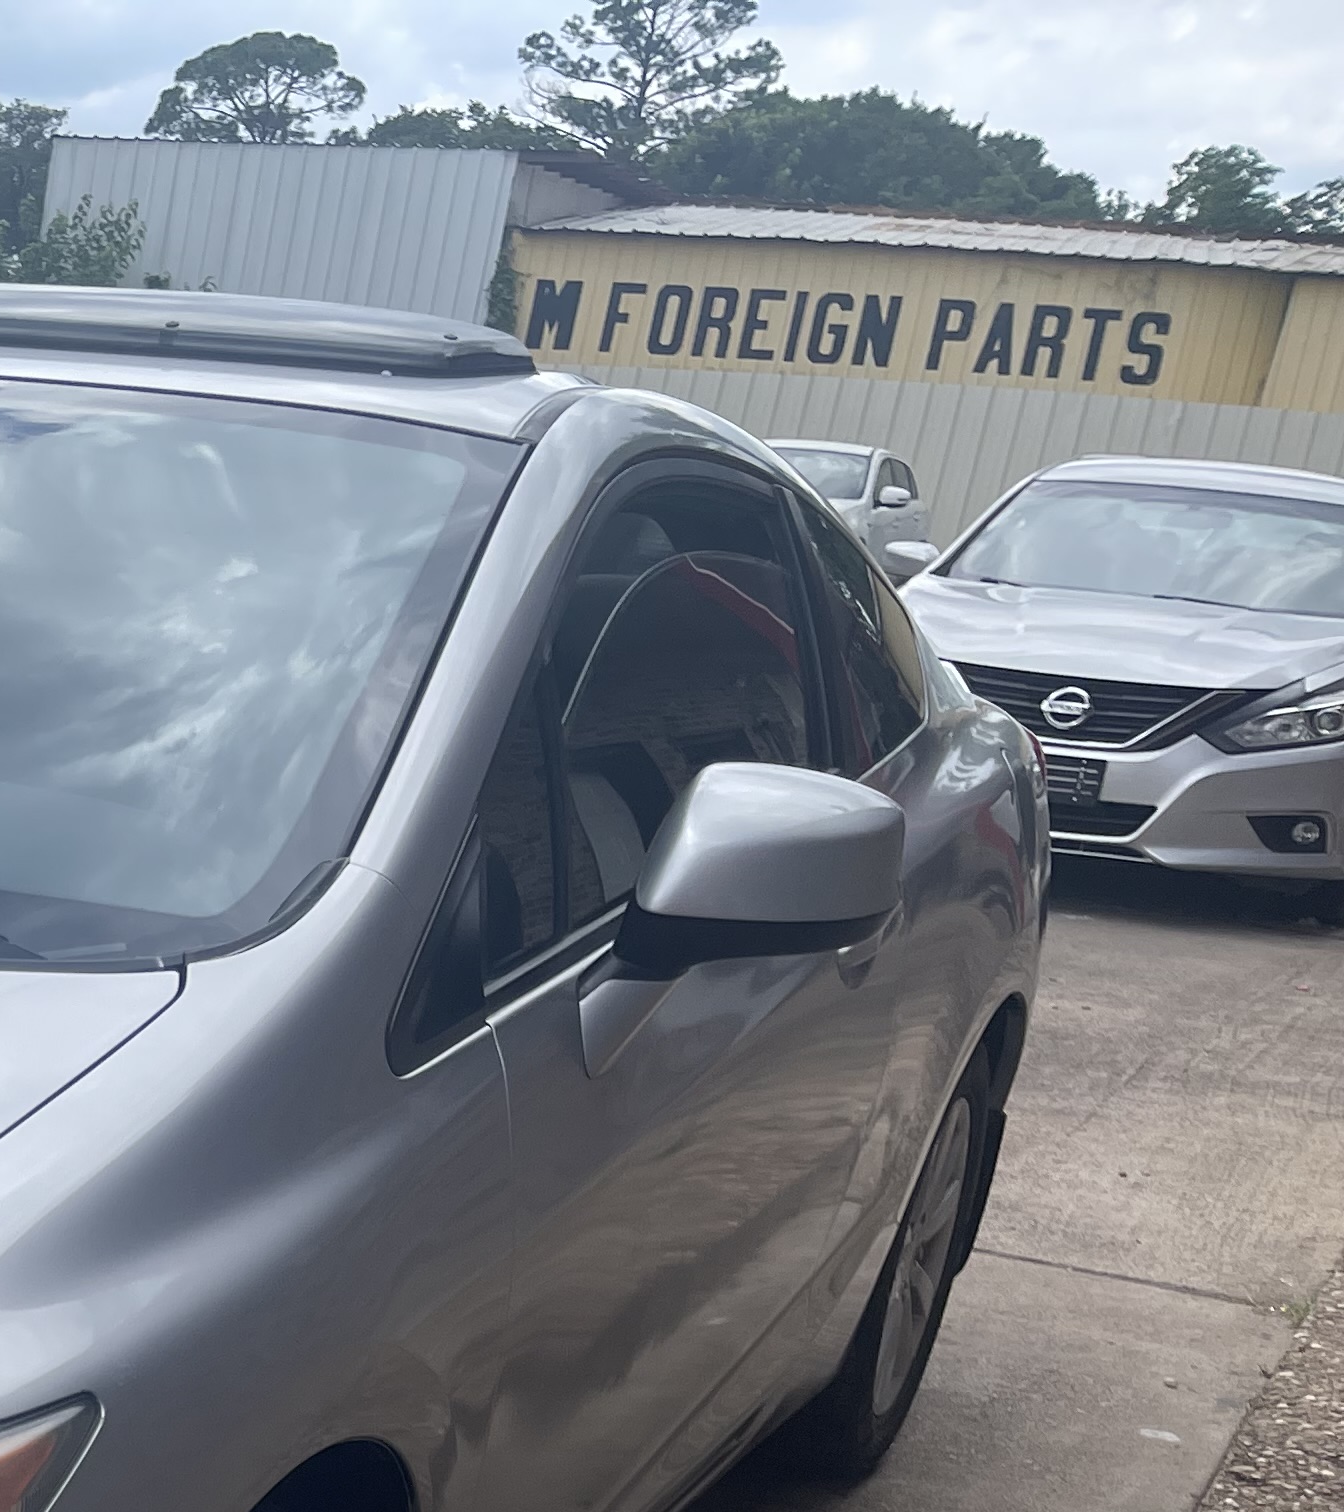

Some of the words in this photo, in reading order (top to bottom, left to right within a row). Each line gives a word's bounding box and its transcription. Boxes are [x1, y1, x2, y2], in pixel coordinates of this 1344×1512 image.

[526, 279, 583, 351] M
[598, 282, 904, 368] FOREIGN
[925, 298, 1172, 386] PARTS
